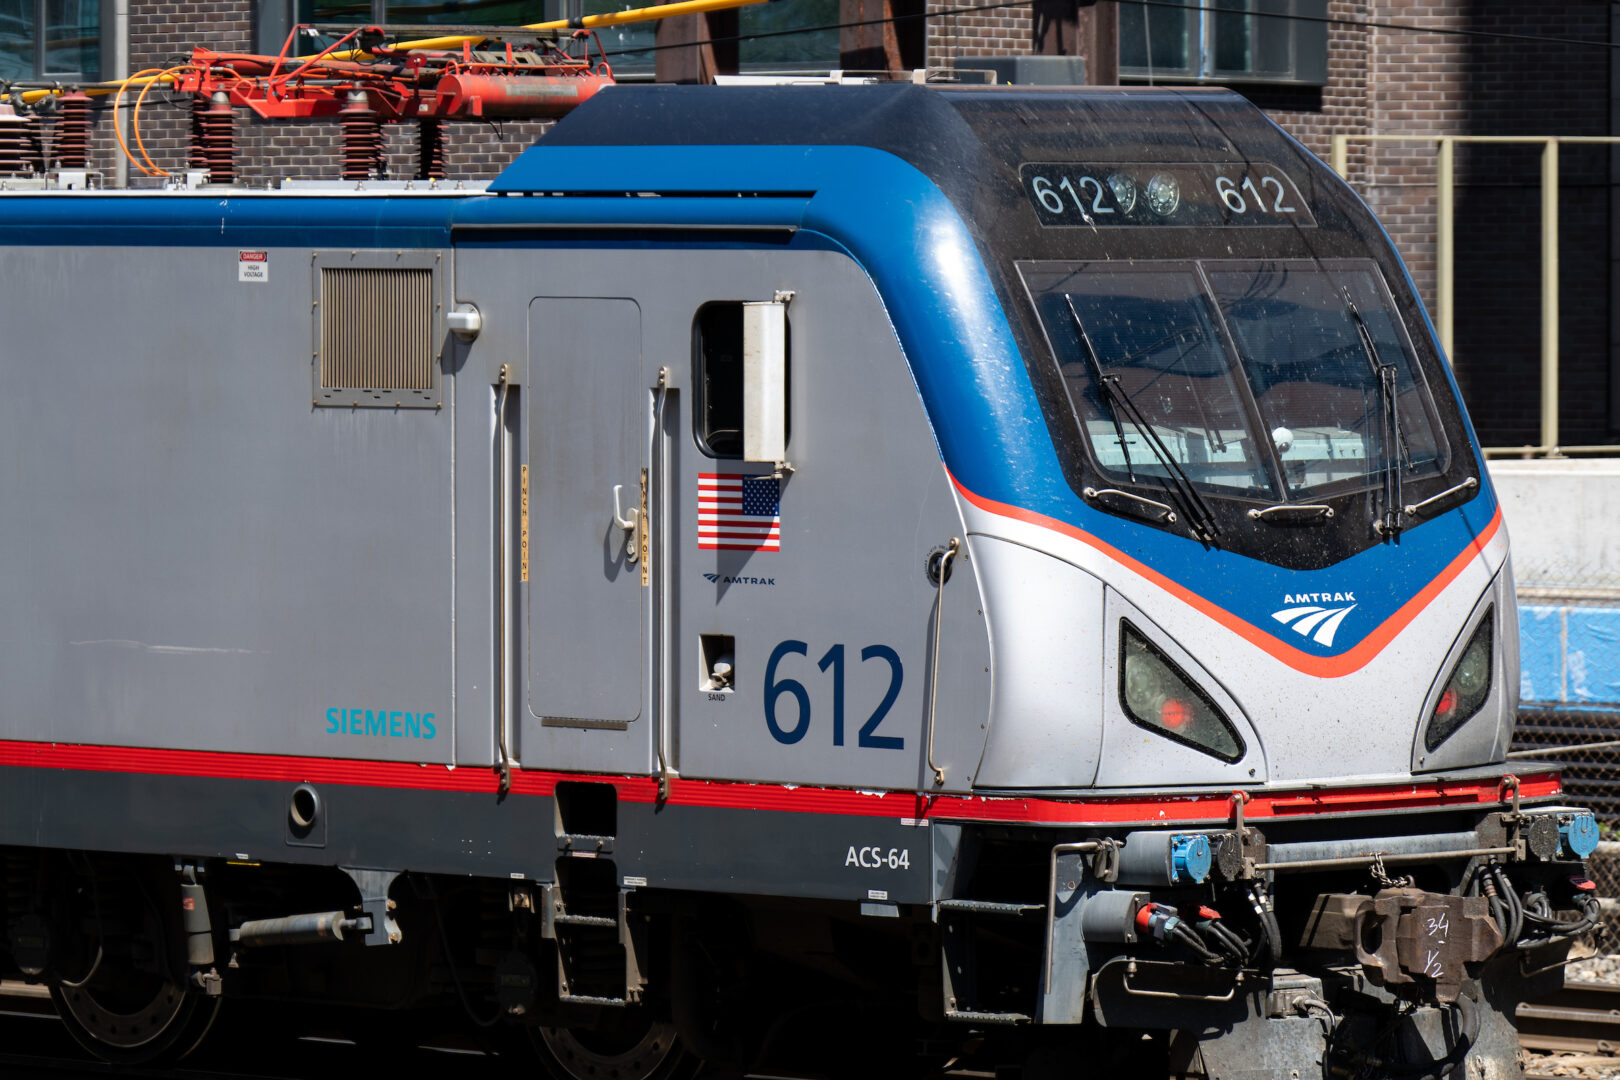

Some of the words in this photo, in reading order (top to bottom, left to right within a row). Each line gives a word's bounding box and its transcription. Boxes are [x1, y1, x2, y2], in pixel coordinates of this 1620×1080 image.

[1032, 175, 1115, 214] 612
[1215, 175, 1296, 214] 612
[723, 576, 775, 586] AMTRAK
[1283, 591, 1356, 604] AMTRAK
[708, 693, 726, 702] SAND
[763, 639, 905, 750] 612
[325, 706, 437, 740] SIEMENS
[844, 845, 910, 870] ACS-64
[1426, 912, 1449, 938] 34
